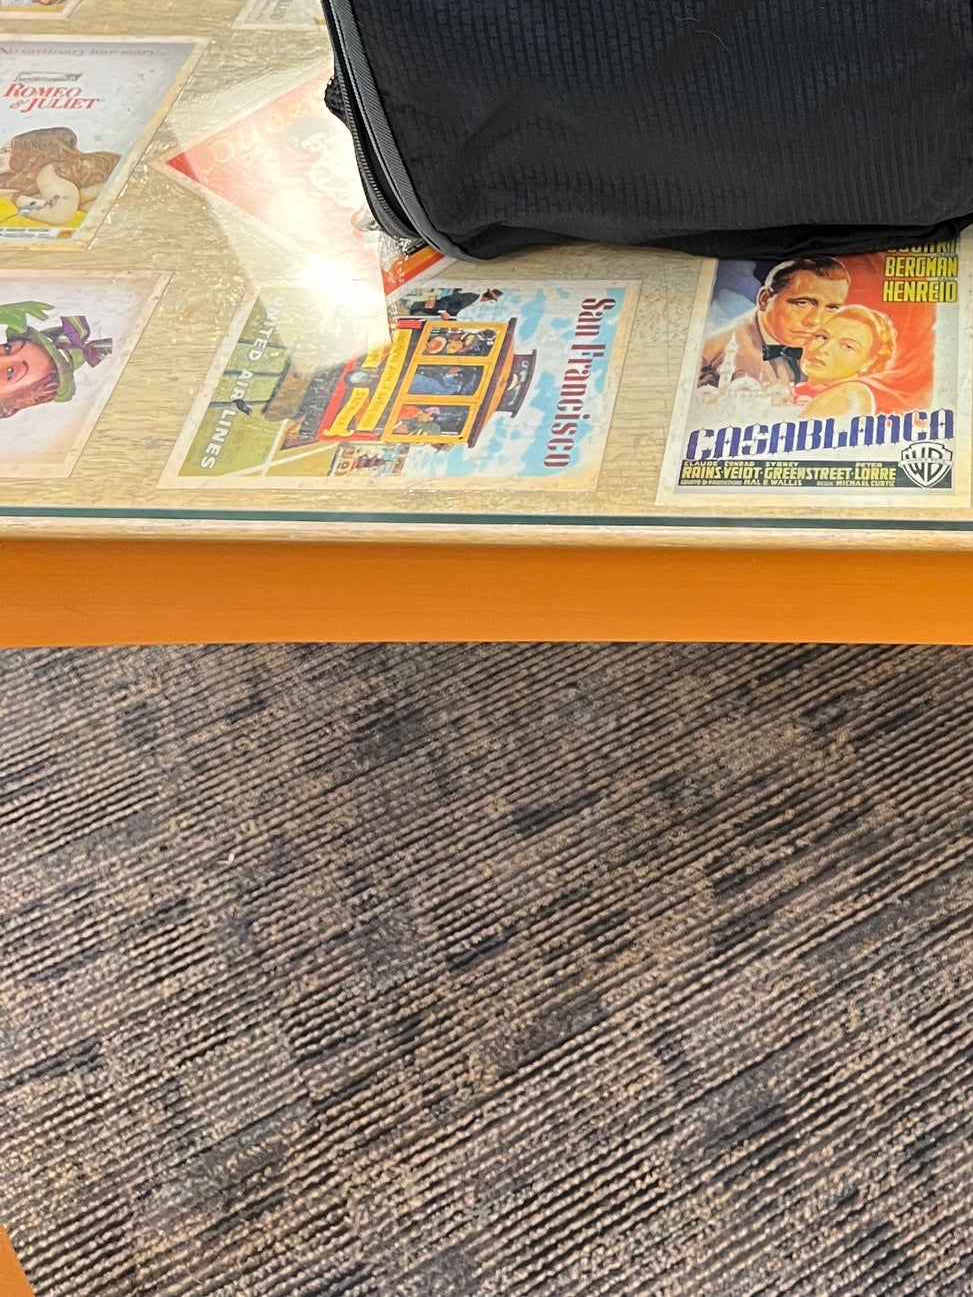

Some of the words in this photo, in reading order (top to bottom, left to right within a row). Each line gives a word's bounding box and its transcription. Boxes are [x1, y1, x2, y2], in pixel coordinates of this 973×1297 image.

[3, 83, 83, 98] ROMEO
[20, 98, 102, 113] JULIET
[885, 256, 958, 277] BERGMAN
[883, 280, 958, 303] HENREID
[574, 298, 616, 337] San
[230, 368, 254, 401] AIR
[543, 344, 606, 467] Francisco
[200, 408, 236, 469] LINES
[685, 408, 955, 461] CASABLANCA
[682, 467, 721, 480] RAINS
[763, 467, 852, 480] GREENSTREET
[854, 467, 897, 480] LORRE
